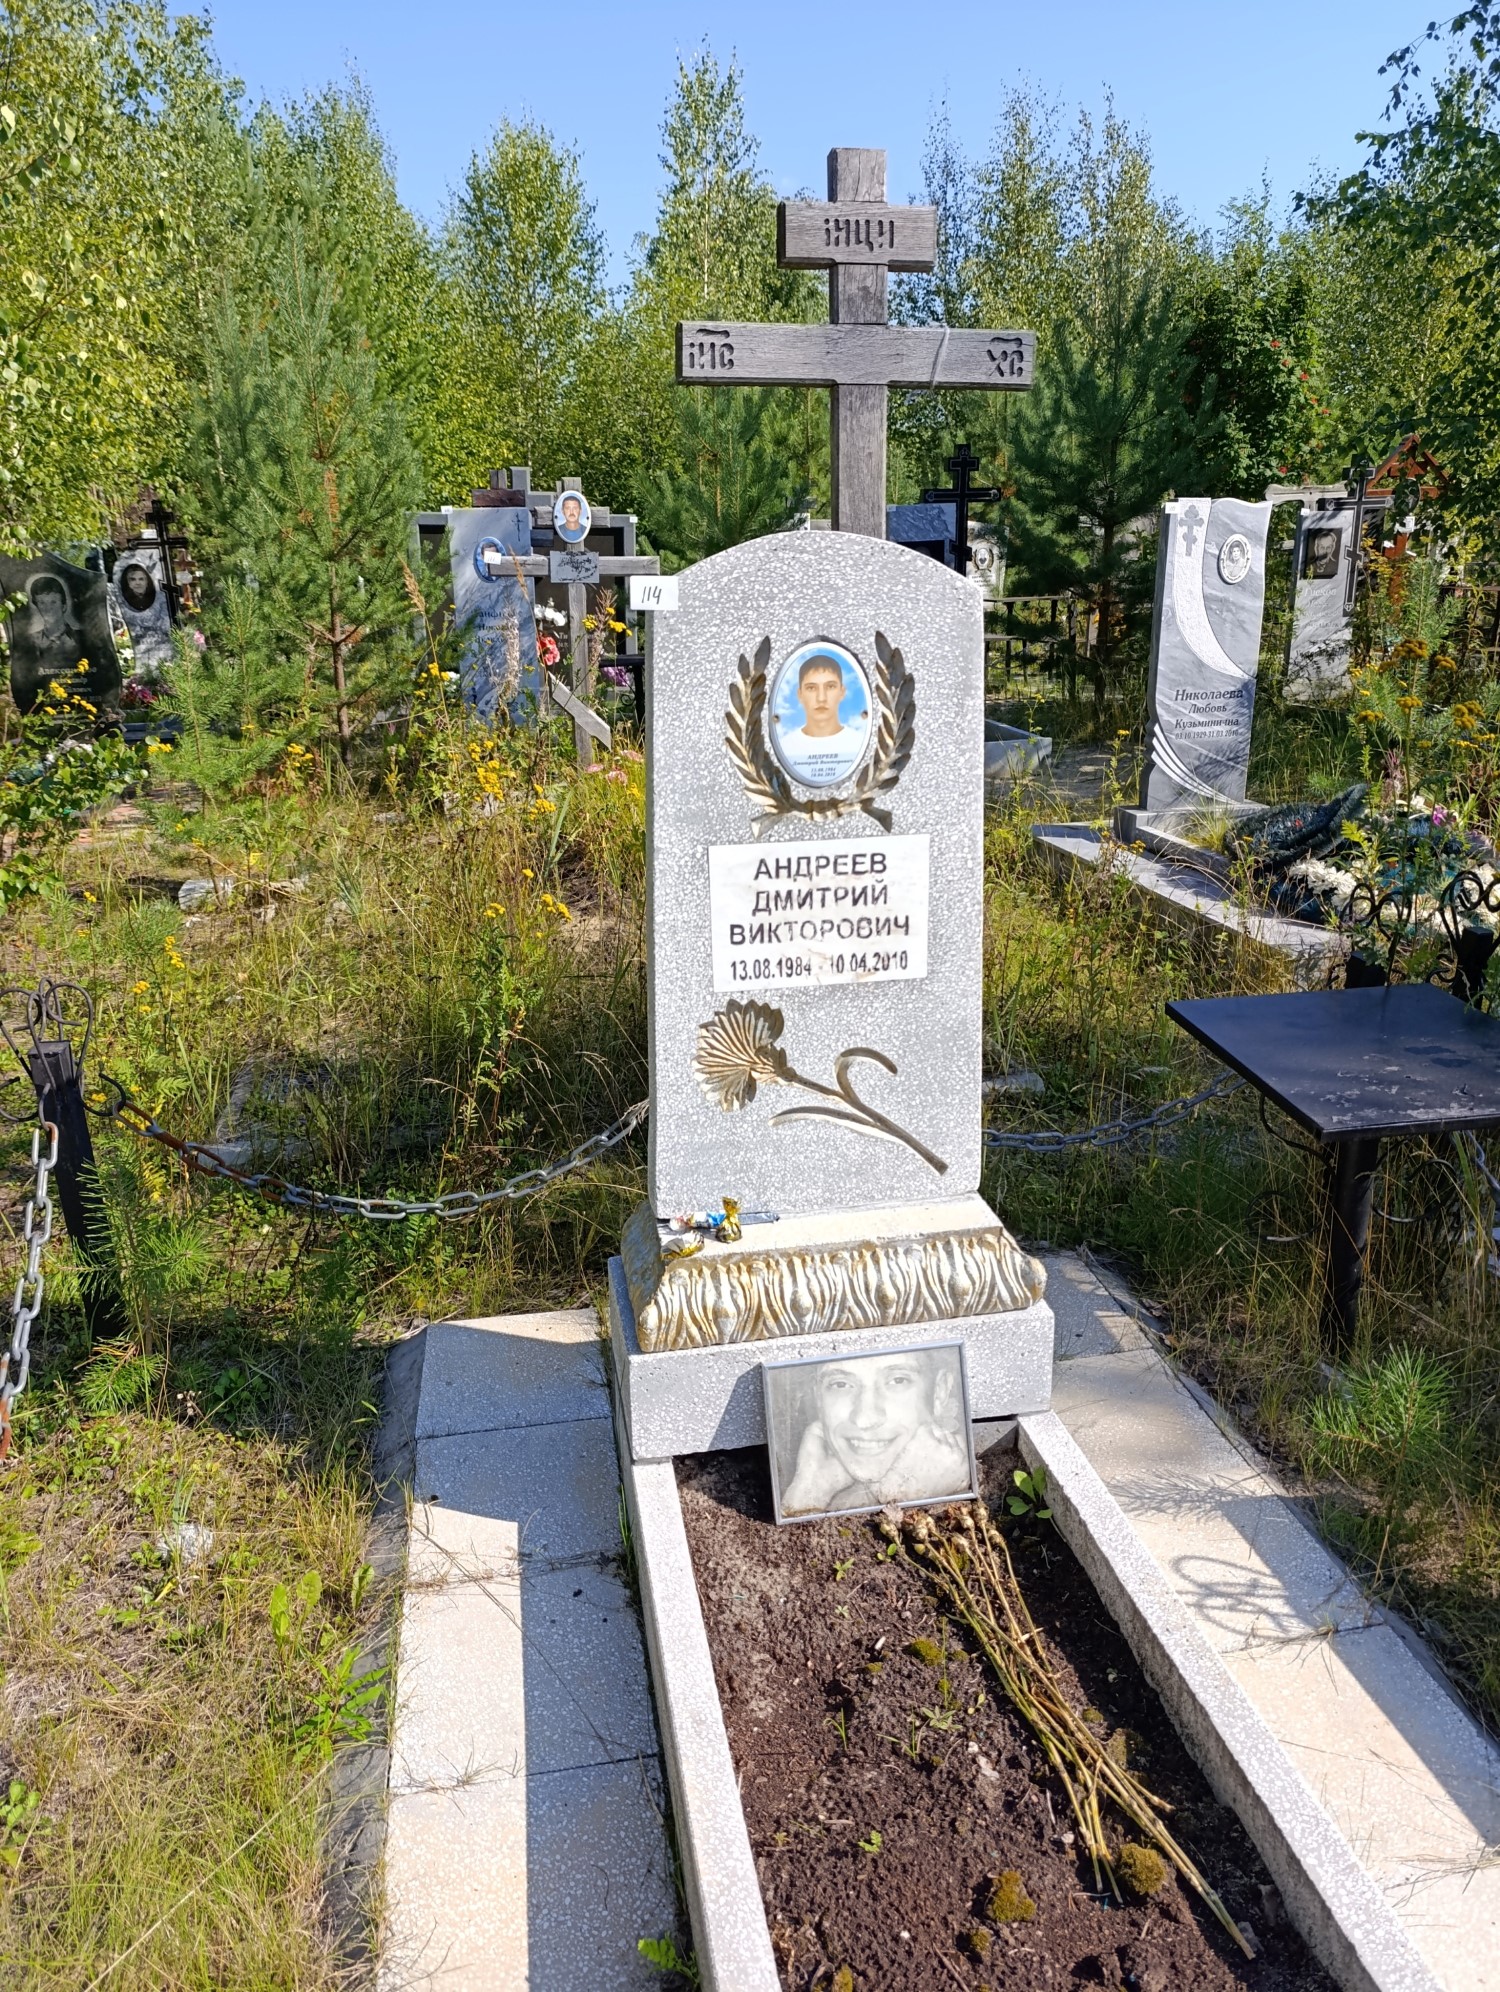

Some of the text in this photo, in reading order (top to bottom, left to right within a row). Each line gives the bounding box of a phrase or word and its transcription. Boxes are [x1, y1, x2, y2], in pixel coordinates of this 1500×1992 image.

[641, 586, 662, 604] 114
[1174, 689, 1244, 701] Николаева
[1188, 702, 1227, 714] Любовь
[754, 853, 887, 882] АНДРЕЕВ
[752, 879, 888, 916] ДМИТРИЙ
[730, 915, 910, 945] ВИКТОРОВИЧ
[731, 956, 812, 981] 13.08.1984
[830, 951, 908, 974] 1004.2010
